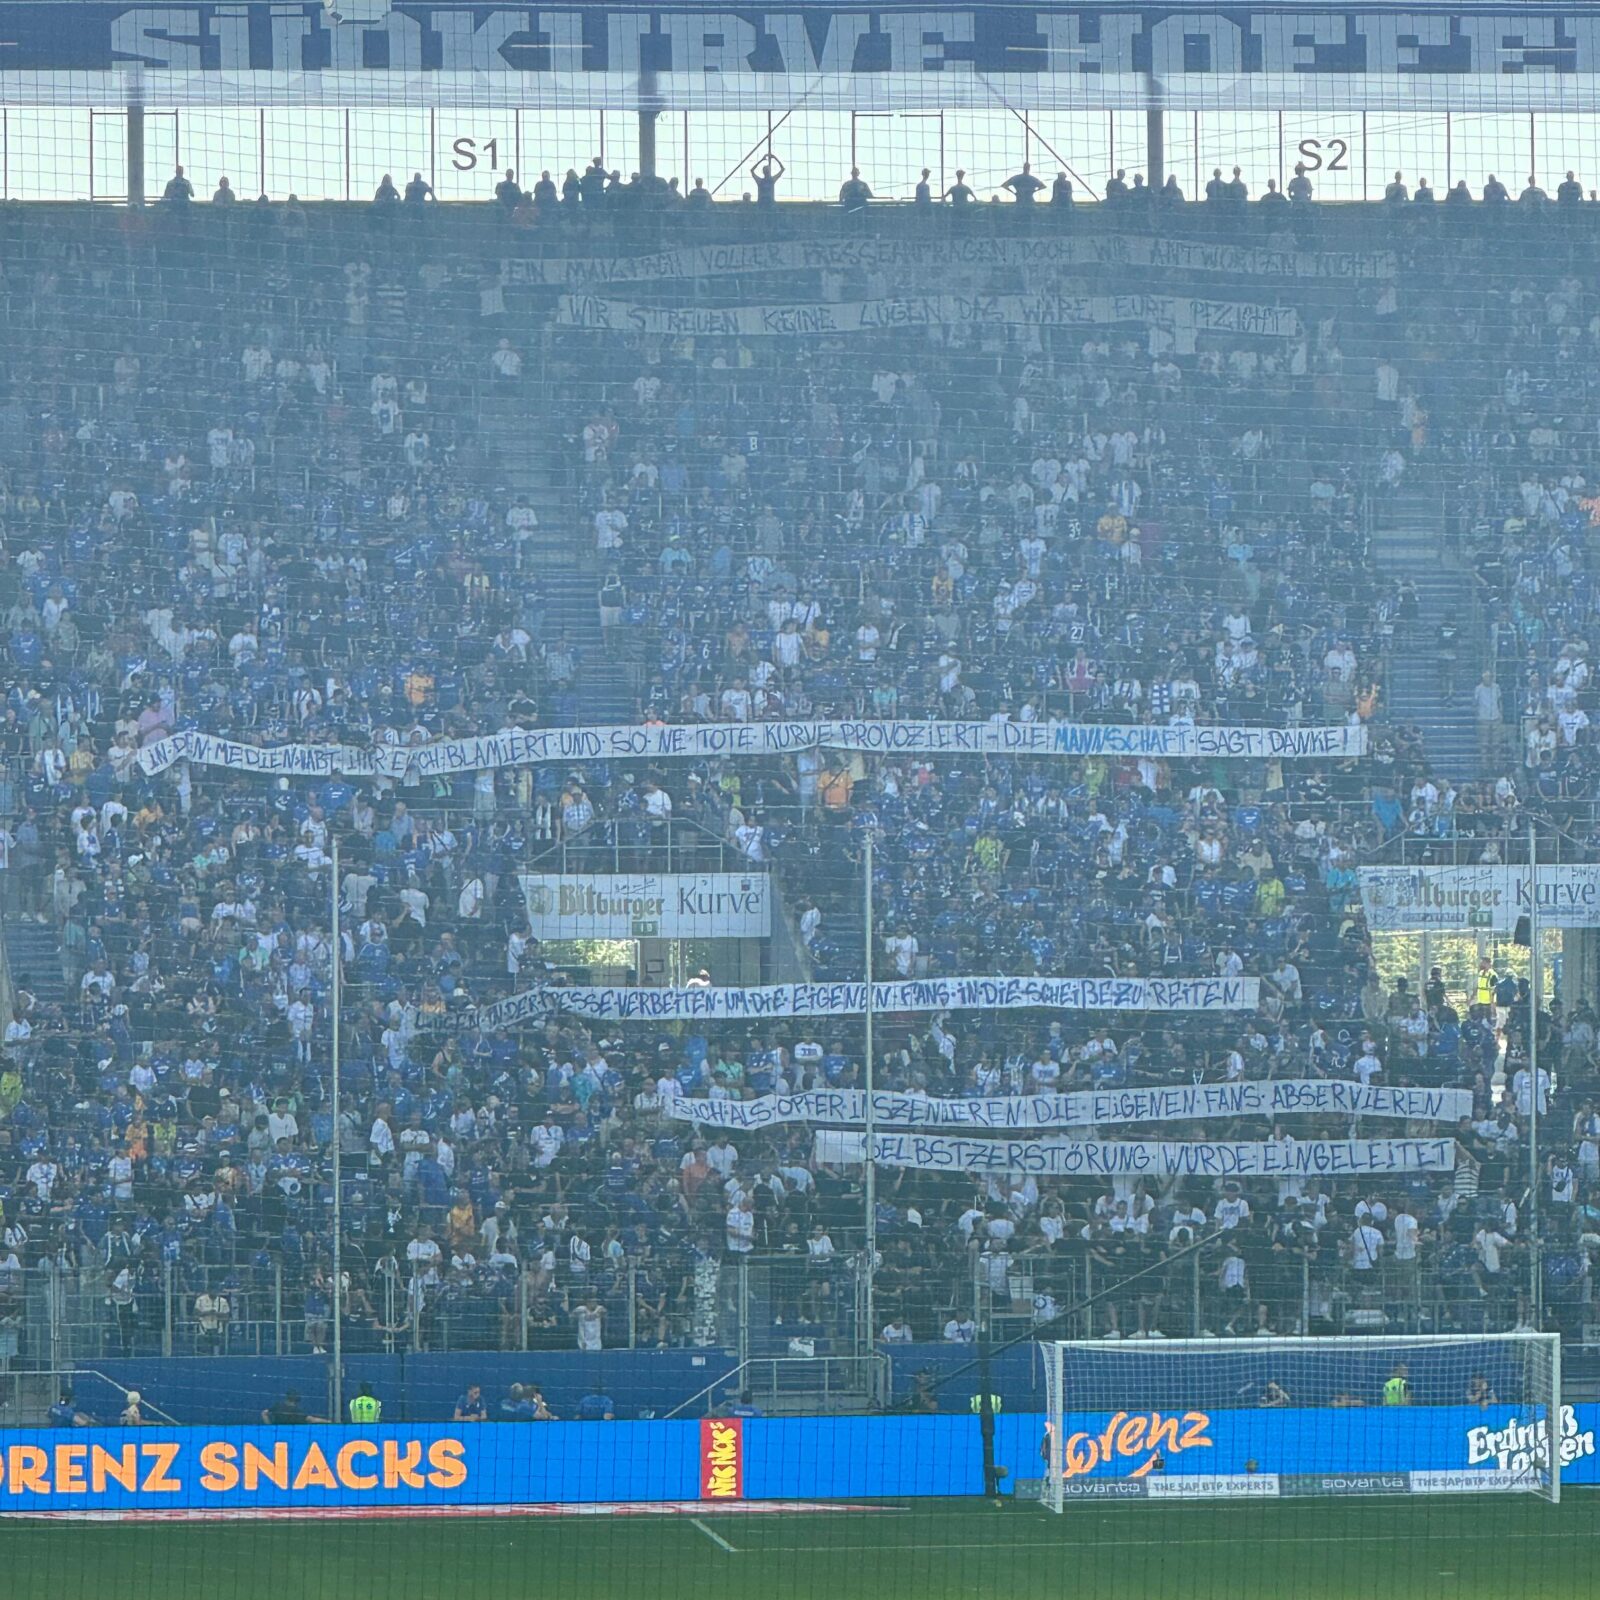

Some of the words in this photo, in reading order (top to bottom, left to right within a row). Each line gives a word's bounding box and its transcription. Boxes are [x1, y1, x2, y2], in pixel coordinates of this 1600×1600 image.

[1035, 13, 1600, 93] HOFFE
[451, 138, 500, 171] S1
[1298, 138, 1348, 171] S2
[508, 260, 546, 283] EIN
[699, 246, 785, 272] VOLLER
[569, 297, 612, 328] WIR
[627, 306, 741, 334] STREUEN
[762, 307, 838, 333] KEINE
[1070, 625, 1084, 640] 27
[147, 742, 169, 770] IN
[171, 732, 209, 760] DEN
[214, 742, 297, 769] MEDIEN
[446, 732, 555, 768] BLAMIERT
[560, 731, 602, 756] UND
[610, 730, 649, 754] SO
[658, 728, 687, 752] NE
[697, 727, 755, 750] TOTE
[765, 724, 833, 751] KURVE
[839, 723, 991, 749] PROVOZIERT
[1004, 722, 1048, 748] DIE
[1055, 726, 1192, 753] MANNSCHAFT
[1197, 730, 1259, 754] SAGT
[559, 883, 665, 920] Bitburger
[679, 885, 760, 914] Kurve
[1396, 871, 1502, 912] itburger
[1516, 878, 1597, 906] Kurve
[504, 994, 539, 1016] DER
[725, 990, 750, 1013] UM
[751, 988, 785, 1013] DIE
[901, 982, 950, 1005] FANS
[957, 982, 978, 1005] IN
[980, 979, 1022, 1005] DIE
[1112, 983, 1144, 1006] ZU
[1149, 980, 1241, 1007] REITEN
[673, 1098, 725, 1123] SICH
[731, 1101, 772, 1126] ALS
[777, 1094, 845, 1120] OPFER
[1032, 1097, 1081, 1123] DIE
[1095, 1090, 1197, 1120] EIGENEN
[1204, 1084, 1261, 1112] FANS
[1271, 1083, 1444, 1117] ABSERVIEREN
[862, 1135, 1150, 1173] SELBSTZERSTÖRUNG
[1162, 1143, 1254, 1173] WURDE
[1263, 1141, 1450, 1173] EINGELEITET
[1045, 1411, 1213, 1478] orenz
[1498, 1431, 1596, 1471] Loen
[0, 1442, 182, 1495] RENZ
[200, 1438, 468, 1491] SNACKS
[1321, 1476, 1405, 1489] sovanta
[1416, 1478, 1438, 1488] THE
[1153, 1481, 1176, 1492] THE
[1178, 1481, 1200, 1492] SAP
[1226, 1480, 1275, 1491] EXPERTS
